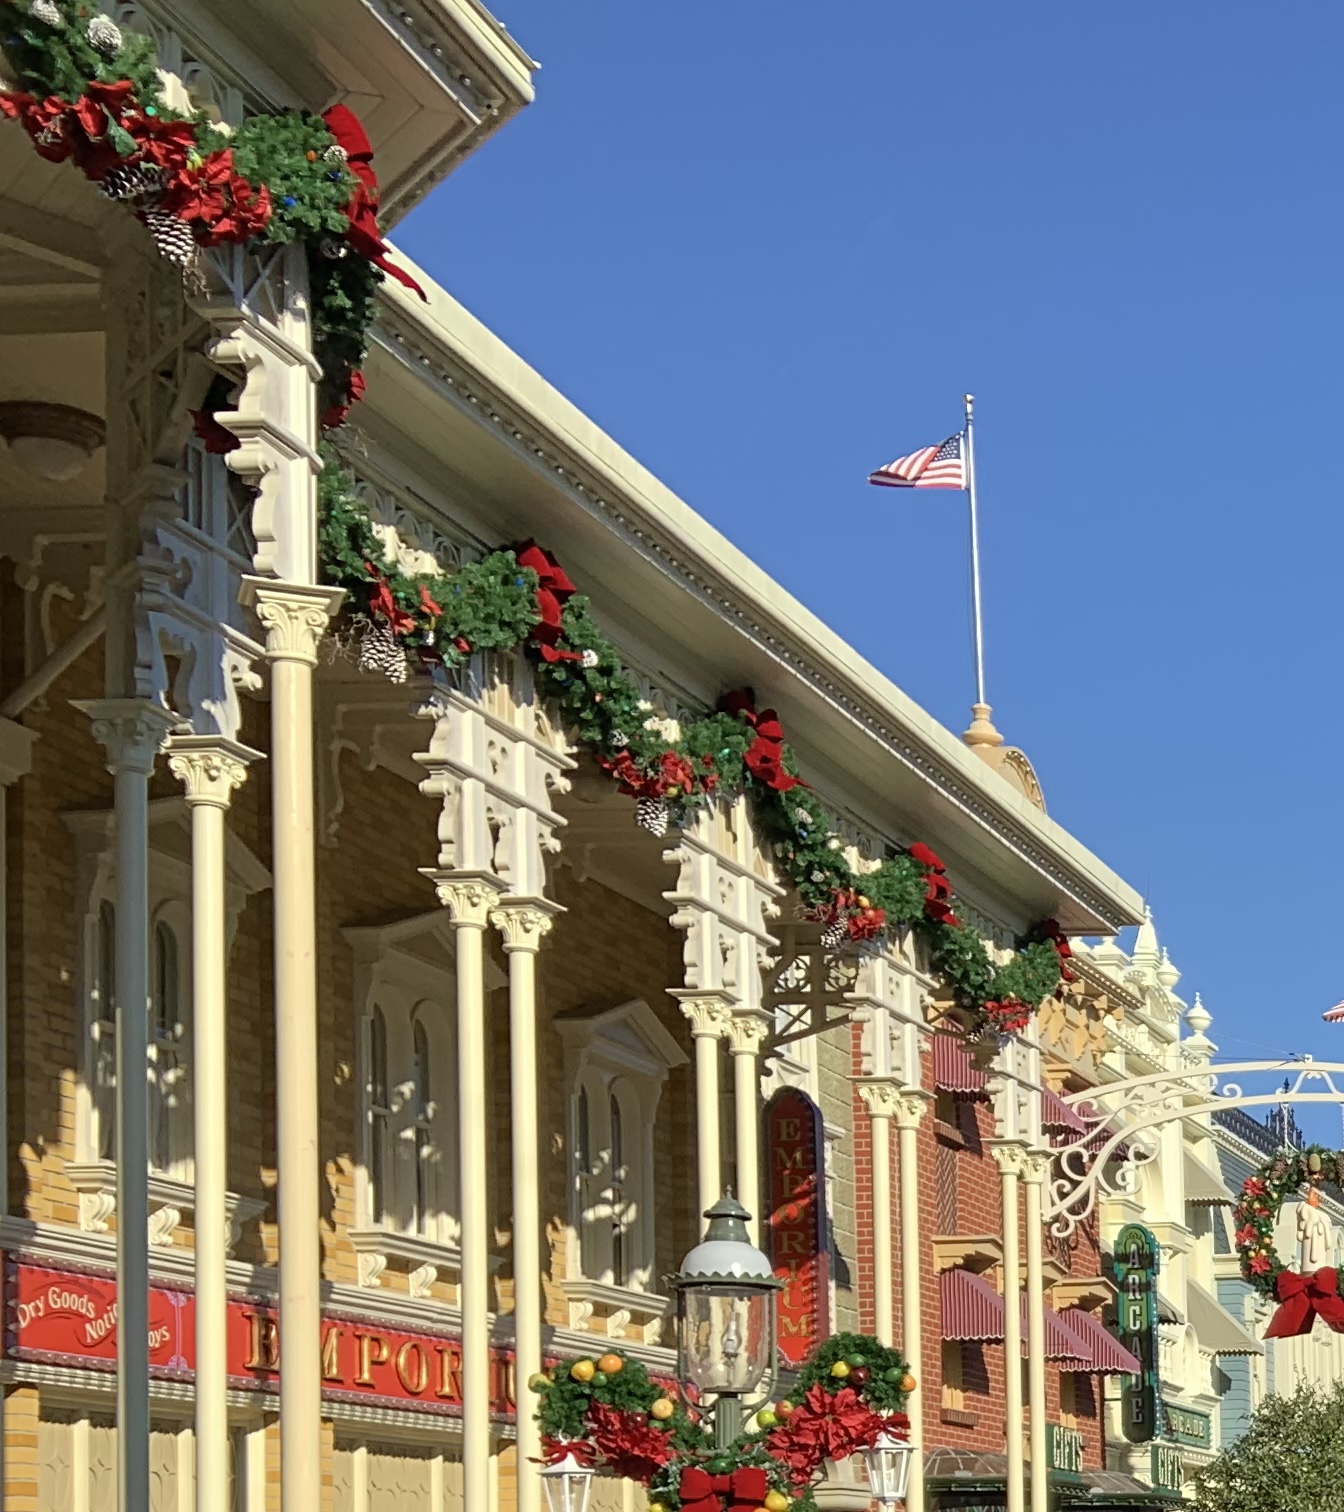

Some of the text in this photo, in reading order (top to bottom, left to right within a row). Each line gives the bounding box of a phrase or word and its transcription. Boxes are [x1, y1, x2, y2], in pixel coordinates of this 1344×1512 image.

[774, 1117, 812, 1338] EMPORIUM
[17, 1286, 96, 1329] Dry Goods
[84, 1303, 118, 1344] Noti
[148, 1324, 171, 1348] oys
[1127, 1243, 1145, 1425] ARCADE
[1171, 1413, 1204, 1437] RCADE
[1053, 1425, 1083, 1472] GIFTS
[1158, 1447, 1185, 1493] GIFTS
